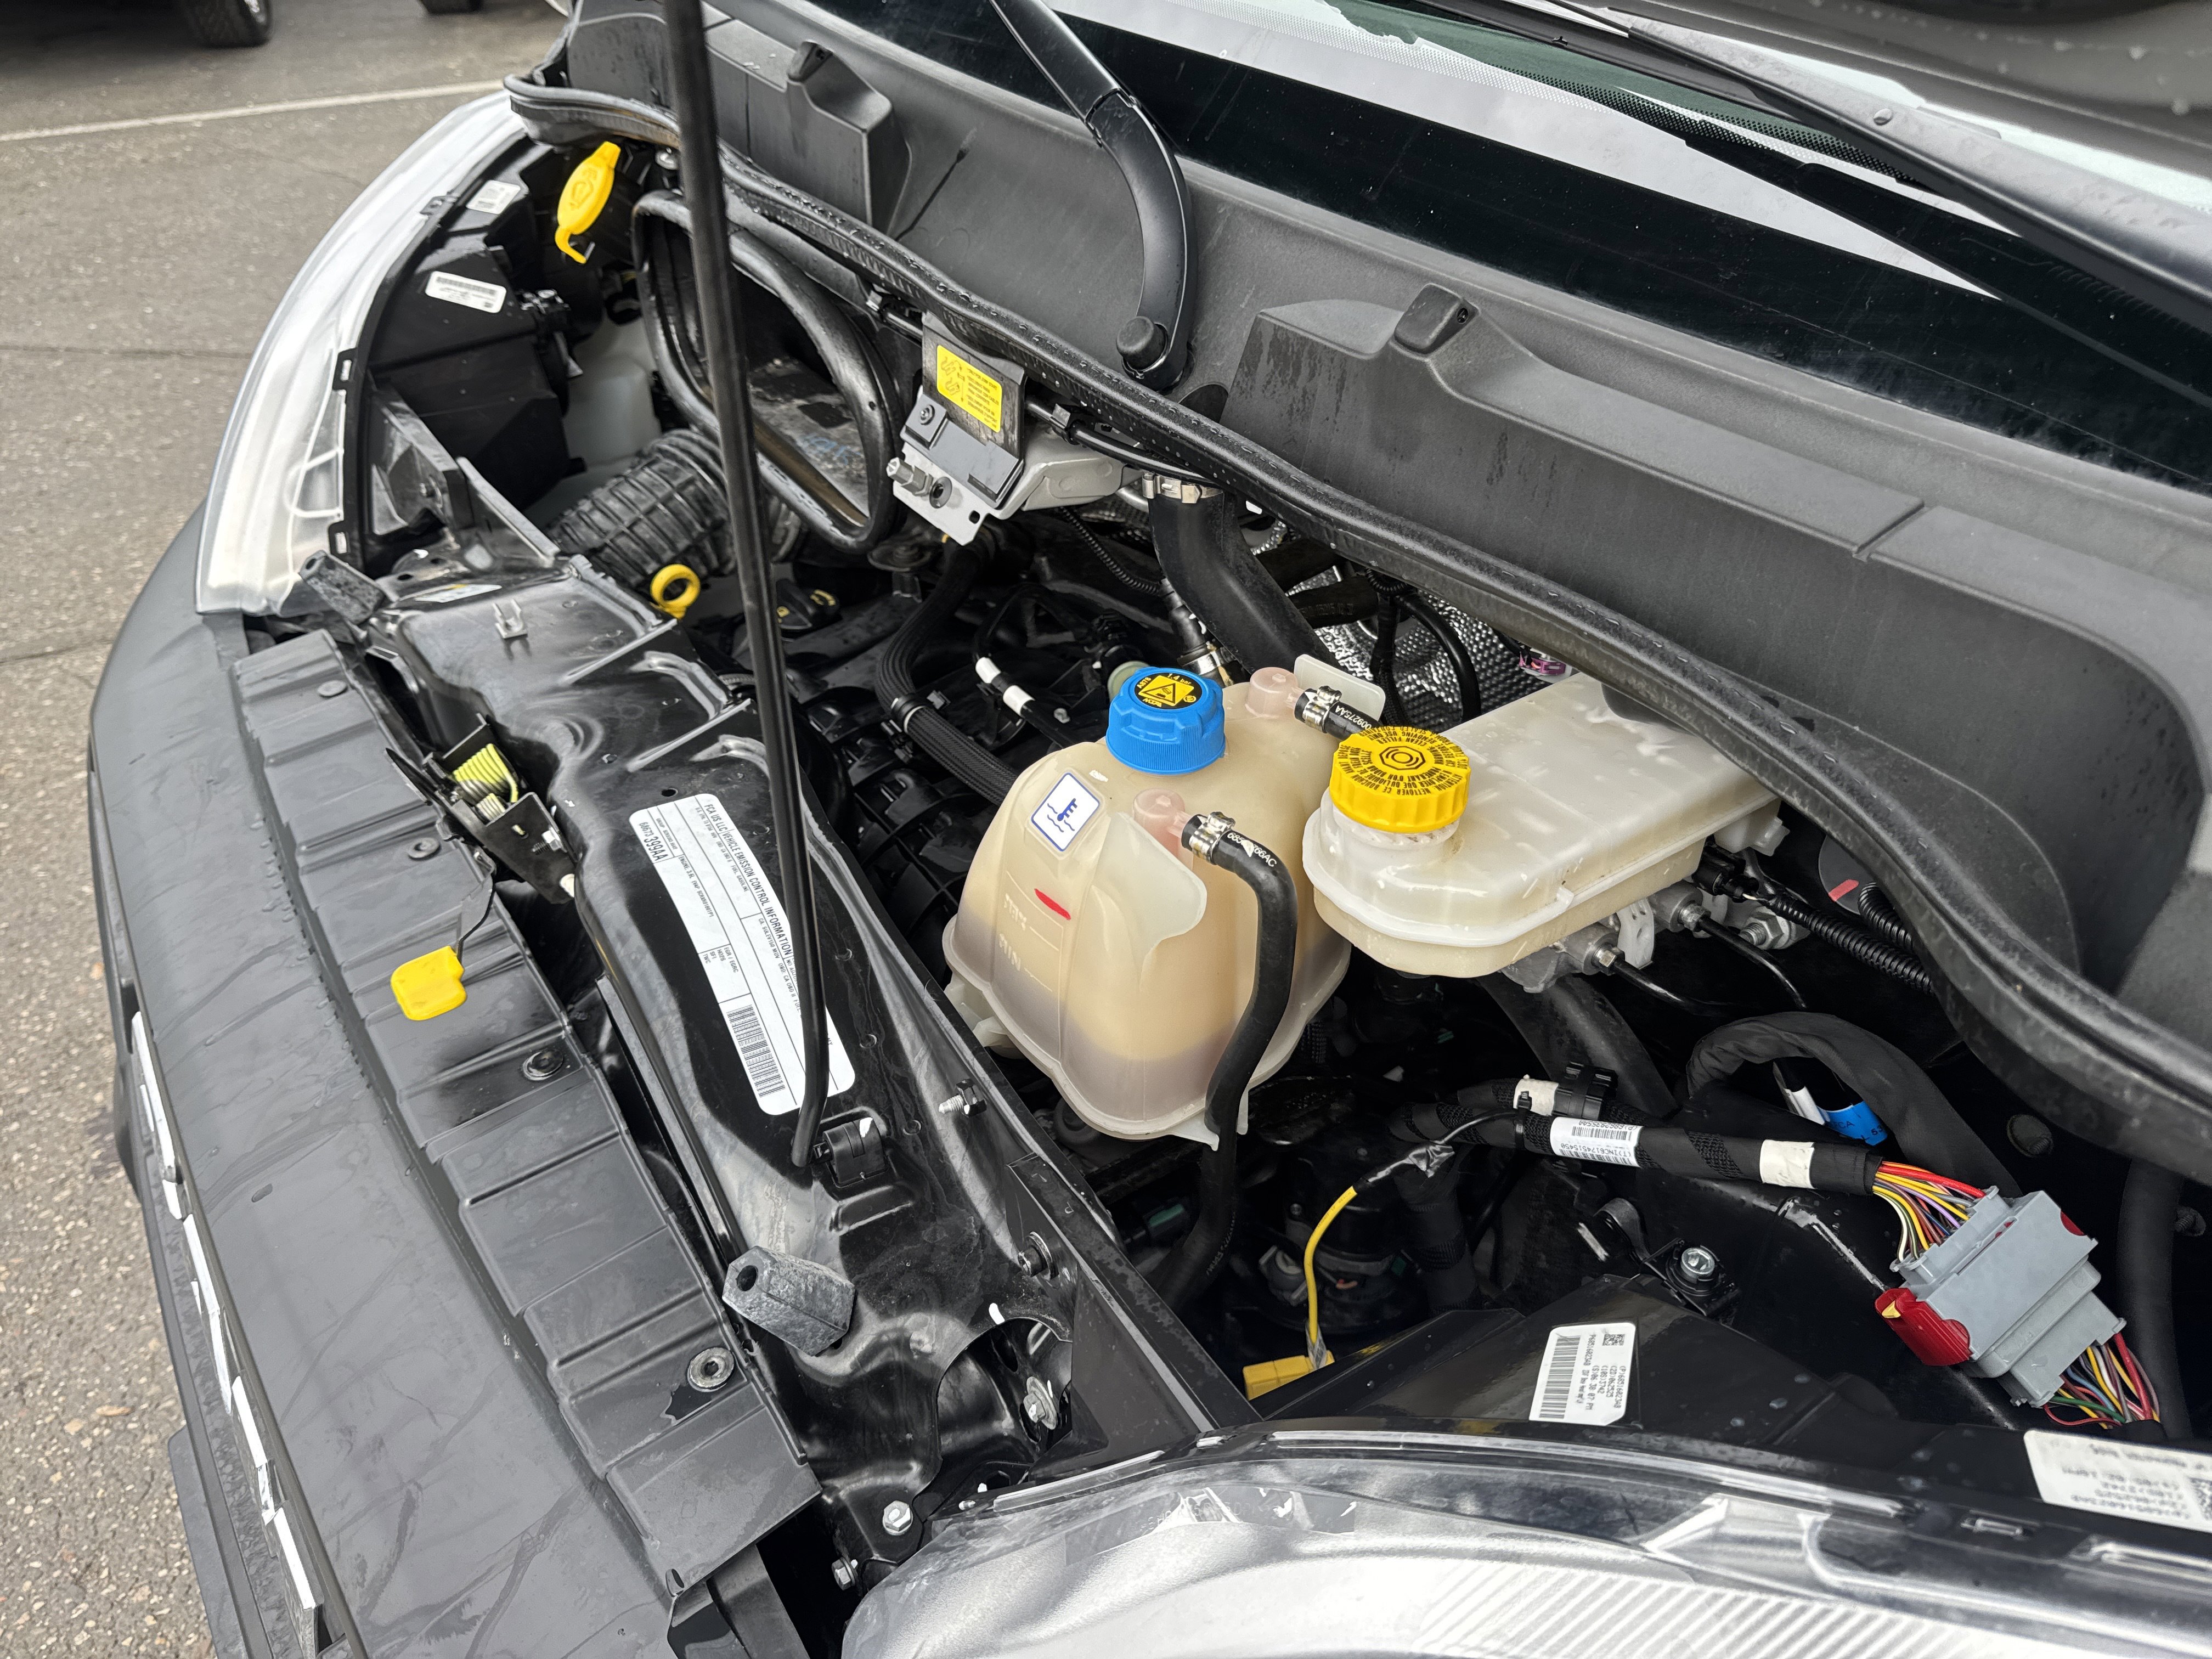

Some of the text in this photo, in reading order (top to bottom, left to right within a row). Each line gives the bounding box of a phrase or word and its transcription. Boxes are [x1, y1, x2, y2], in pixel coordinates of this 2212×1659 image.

[1358, 725, 1396, 737] CONTAINER
[1366, 731, 1382, 741] ONLY
[1400, 725, 1426, 734] SEALED
[1375, 736, 1401, 744] FILLER
[1401, 731, 1436, 744] REMOVING
[1405, 737, 1427, 746] CLEAN
[1435, 732, 1452, 745] FROM
[1435, 743, 1455, 758] BEFORE
[1449, 745, 1466, 757] FLUID
[1338, 761, 1354, 774] AVANT
[1349, 757, 1361, 769] FREIN
[1356, 766, 1368, 775] DE
[1367, 764, 1386, 777] BIDON
[1407, 766, 1441, 781] PROVENANT
[1350, 774, 1380, 790] BOUCHON
[1367, 773, 1391, 787] LIQUIDE
[704, 804, 716, 814] FCA
[715, 822, 727, 831] LLC
[1227, 831, 1277, 866] 685766AC
[722, 832, 793, 955] VEHICLE EMISSION CONTROL INFORMATION
[703, 953, 711, 963] TWC
[729, 960, 738, 973] EGRC
